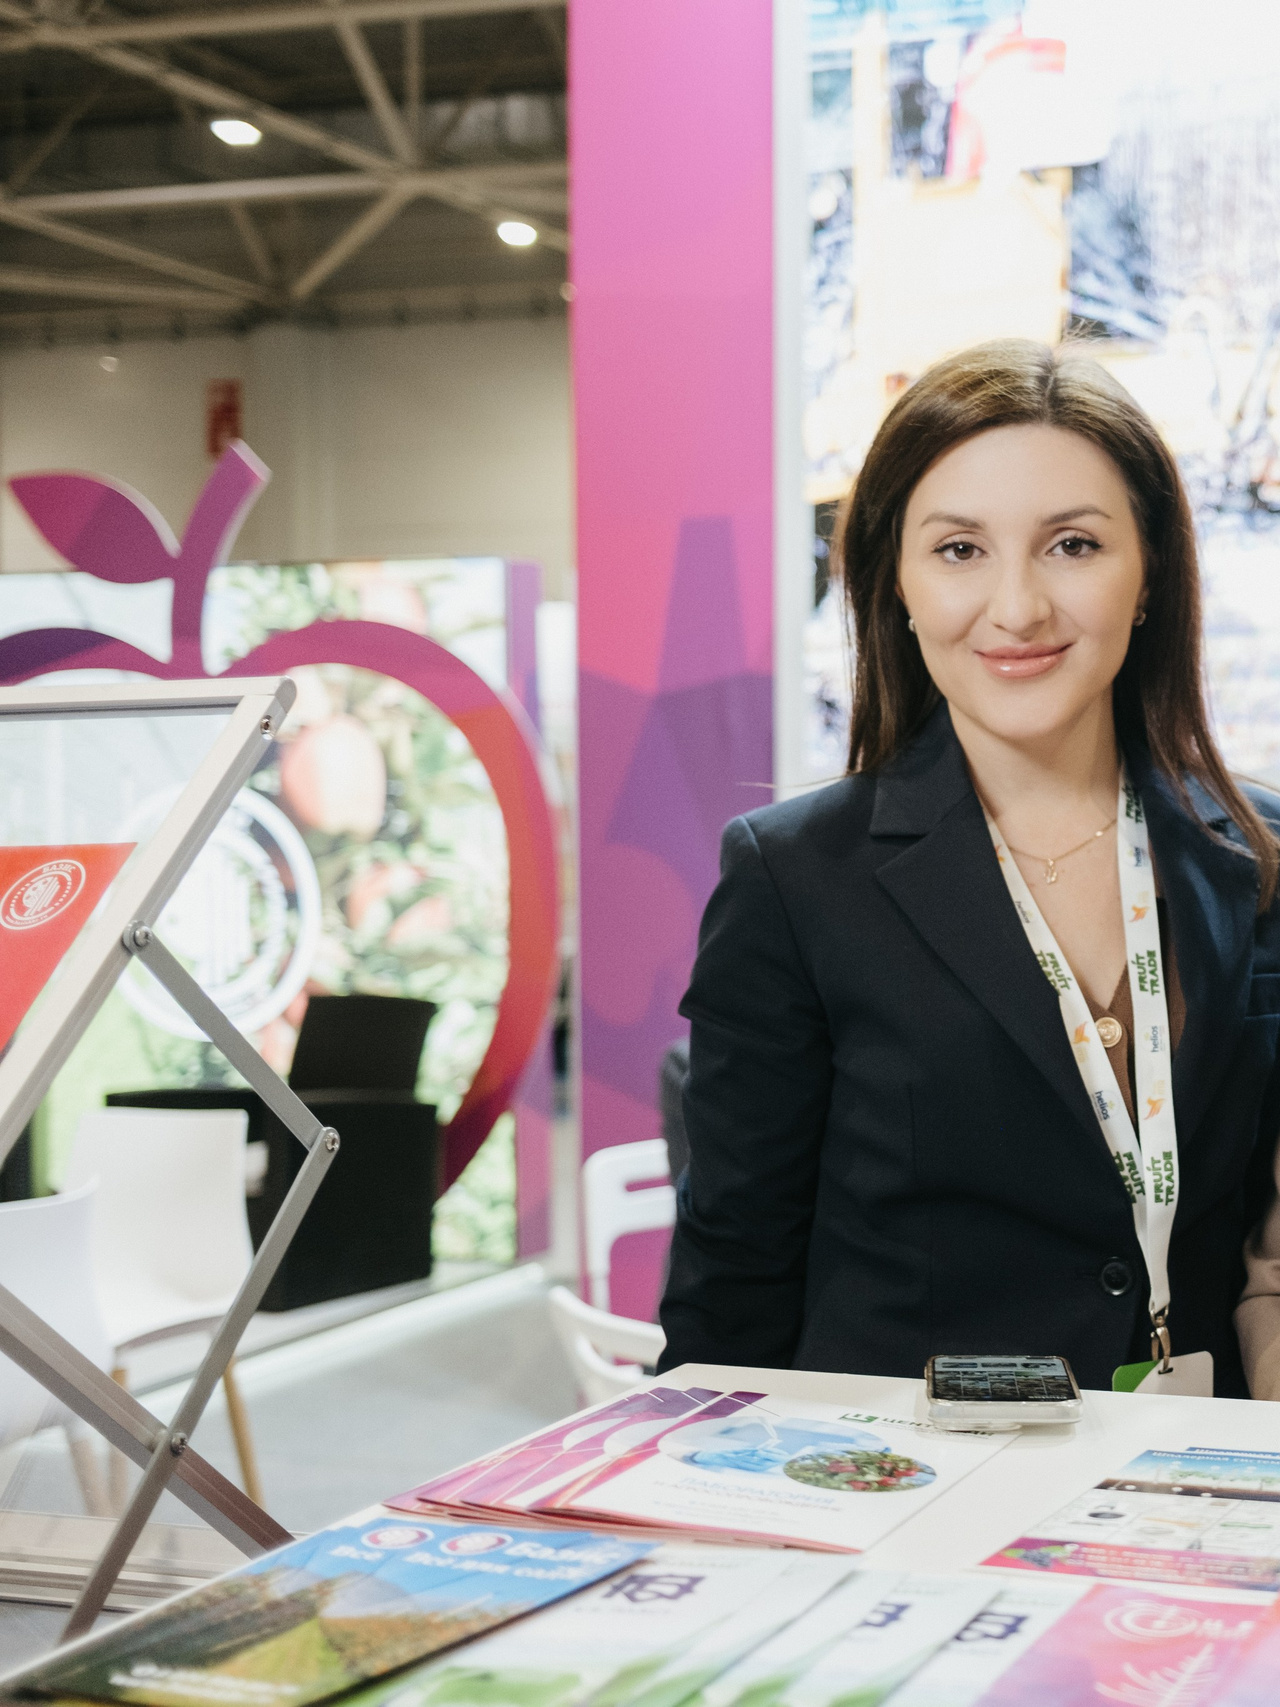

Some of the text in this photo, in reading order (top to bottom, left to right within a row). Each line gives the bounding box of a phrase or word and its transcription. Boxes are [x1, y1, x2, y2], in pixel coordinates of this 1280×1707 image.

[1147, 950, 1160, 996] TRADE
[1094, 1090, 1110, 1120] helios
[1162, 1151, 1175, 1206] TRADE
